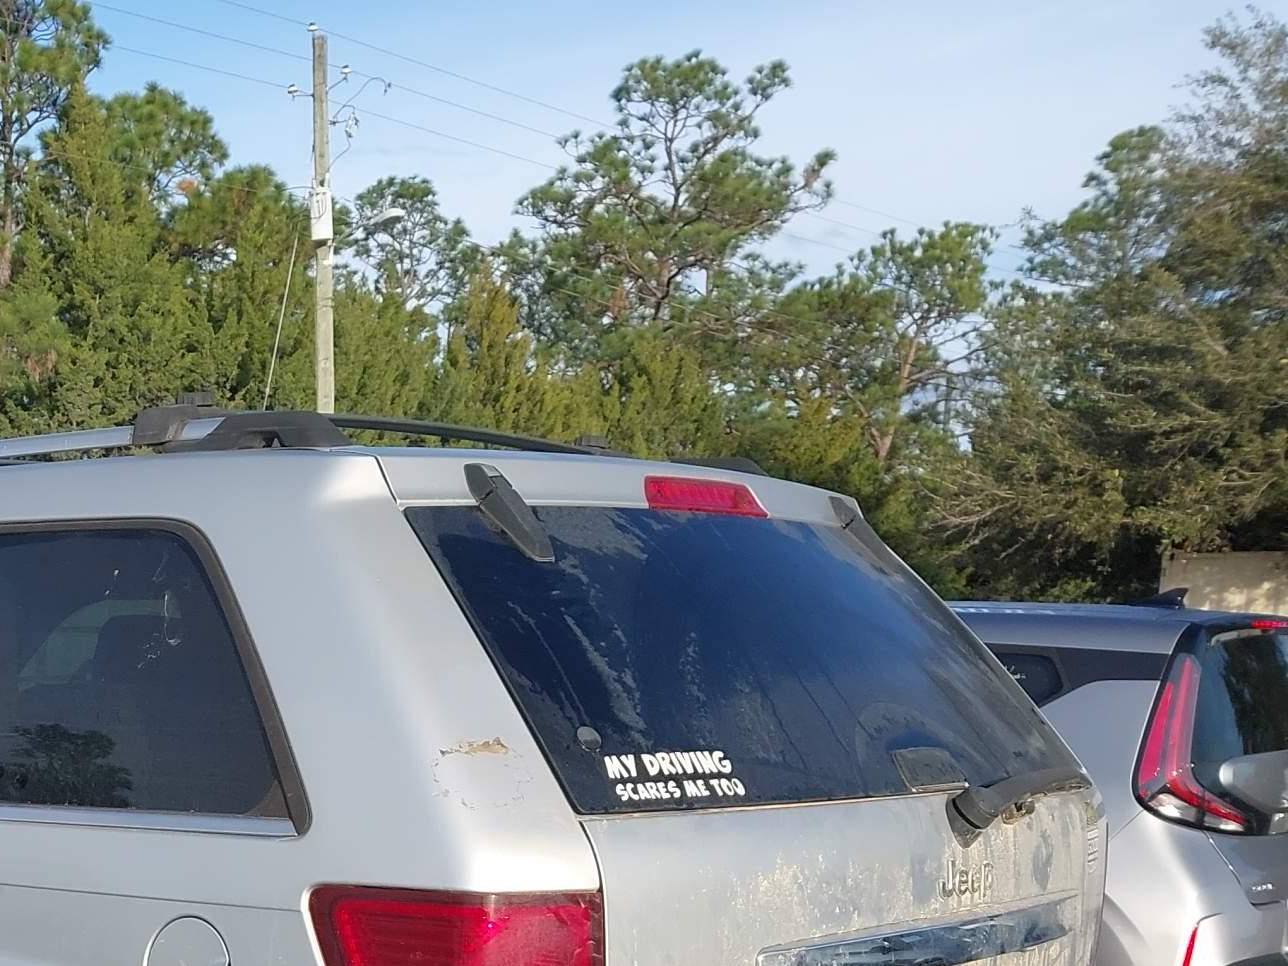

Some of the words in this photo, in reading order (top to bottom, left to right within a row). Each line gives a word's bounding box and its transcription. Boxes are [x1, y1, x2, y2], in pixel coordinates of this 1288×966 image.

[603, 754, 638, 779] MY
[640, 750, 733, 777] DRIVING
[615, 780, 682, 802] SCARES
[682, 779, 711, 798] ME
[709, 777, 747, 797] TOO
[936, 857, 994, 901] Jeep
